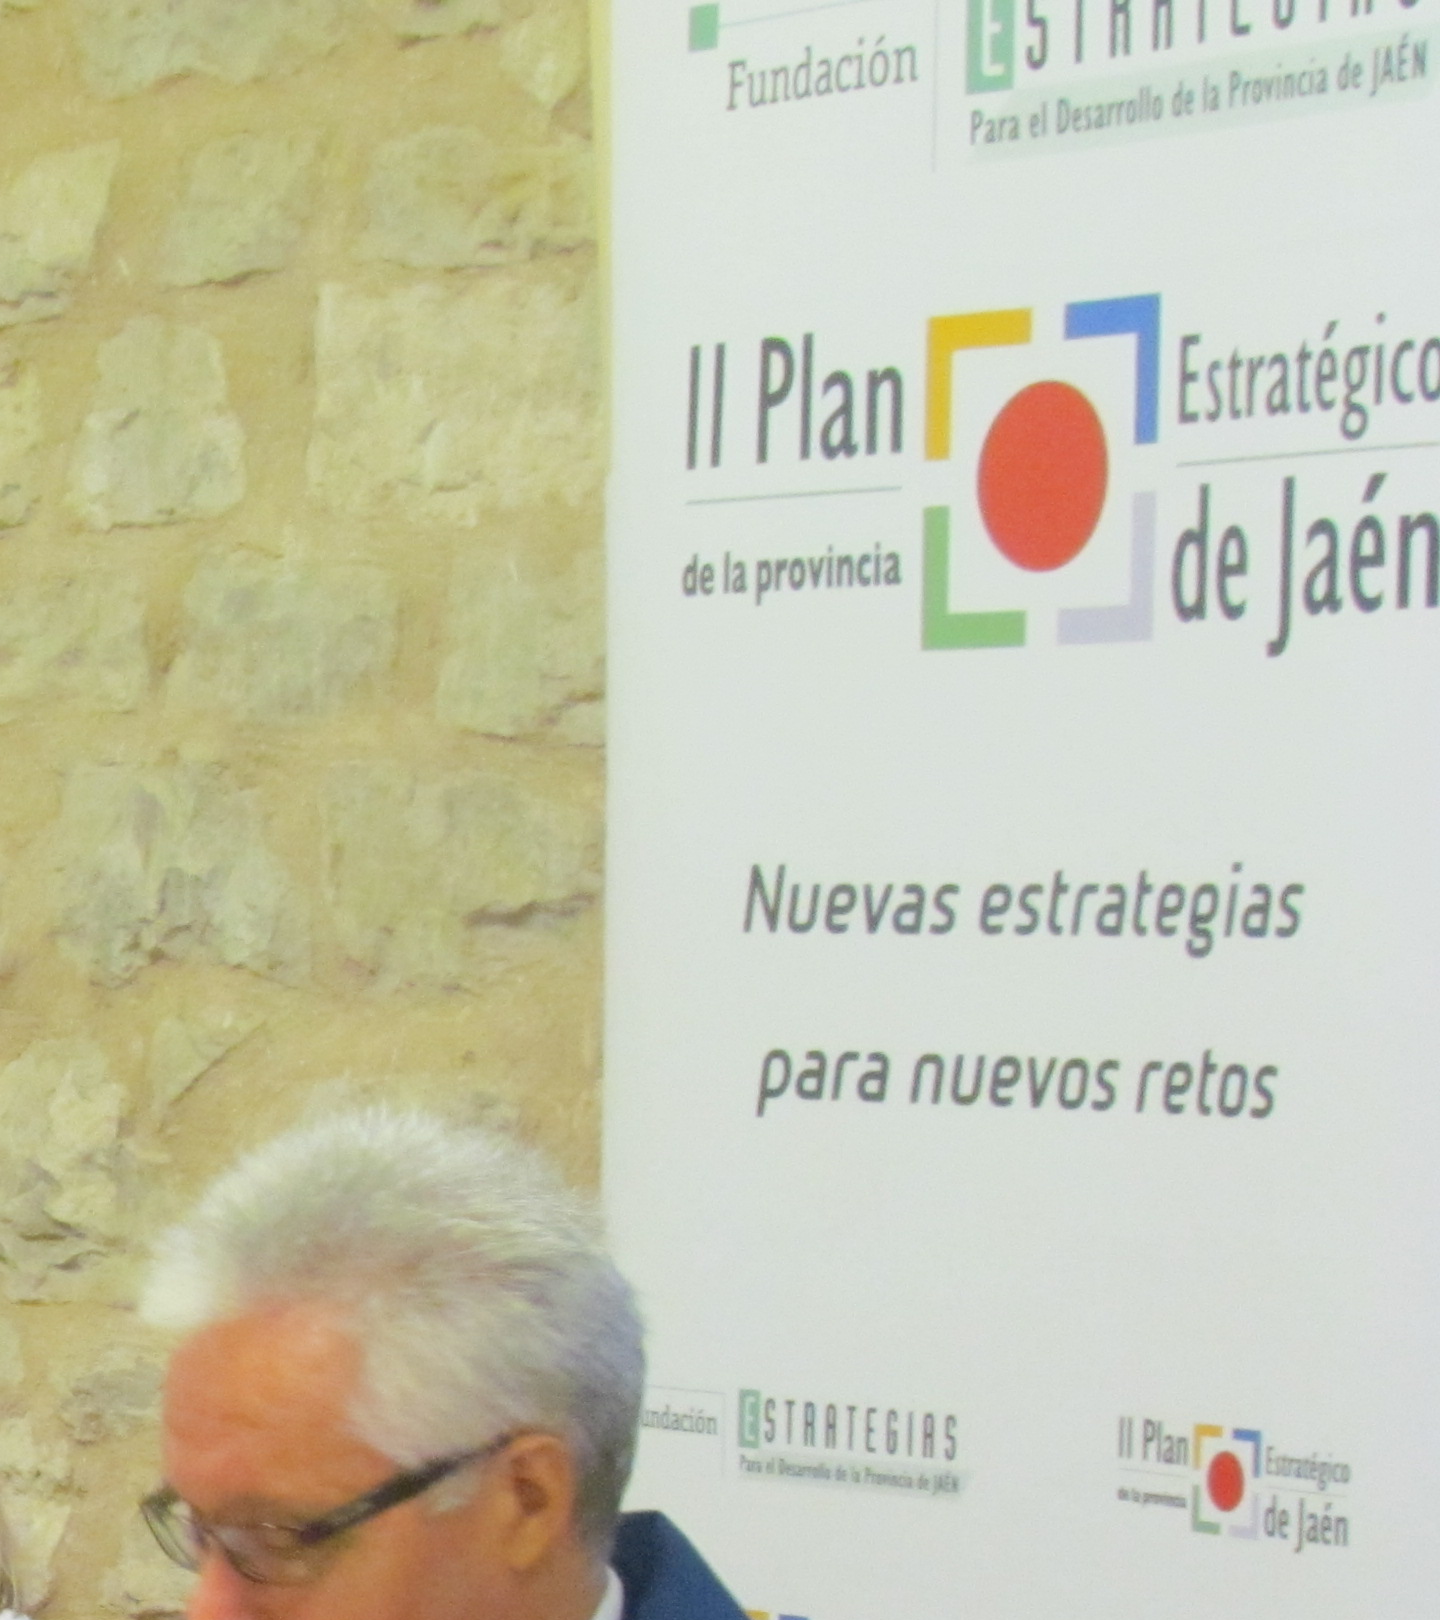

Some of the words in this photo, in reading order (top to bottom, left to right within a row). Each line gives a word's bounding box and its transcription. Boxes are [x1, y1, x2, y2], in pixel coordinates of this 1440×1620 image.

[725, 40, 919, 111] Fundación
[969, 109, 1020, 146] Para
[1029, 111, 1048, 138] el
[1056, 85, 1164, 134] Desarrollo
[1171, 85, 1195, 117] de
[1202, 75, 1219, 112] la
[1228, 57, 1328, 107] Provincia
[1336, 52, 1362, 90] de
[1368, 33, 1428, 97] JAÉN
[685, 342, 726, 470] II
[755, 333, 905, 465] Plan
[1176, 312, 1440, 441] Estratégico
[681, 553, 715, 597] de
[722, 550, 748, 595] la
[755, 541, 903, 606] provincia
[1171, 483, 1250, 623] de
[1266, 471, 1440, 657] Jaén
[742, 862, 961, 937] Nuevas
[978, 861, 1306, 960] estrategias
[755, 1046, 891, 1118] para
[908, 1050, 1121, 1113] nuevos
[1133, 1047, 1280, 1120] retos
[640, 1404, 719, 1436] undación
[740, 1391, 959, 1463] ESTRATEGIAS
[1142, 1417, 1189, 1466] Plan
[1264, 1494, 1289, 1540] de
[1294, 1497, 1348, 1553] Jaén
